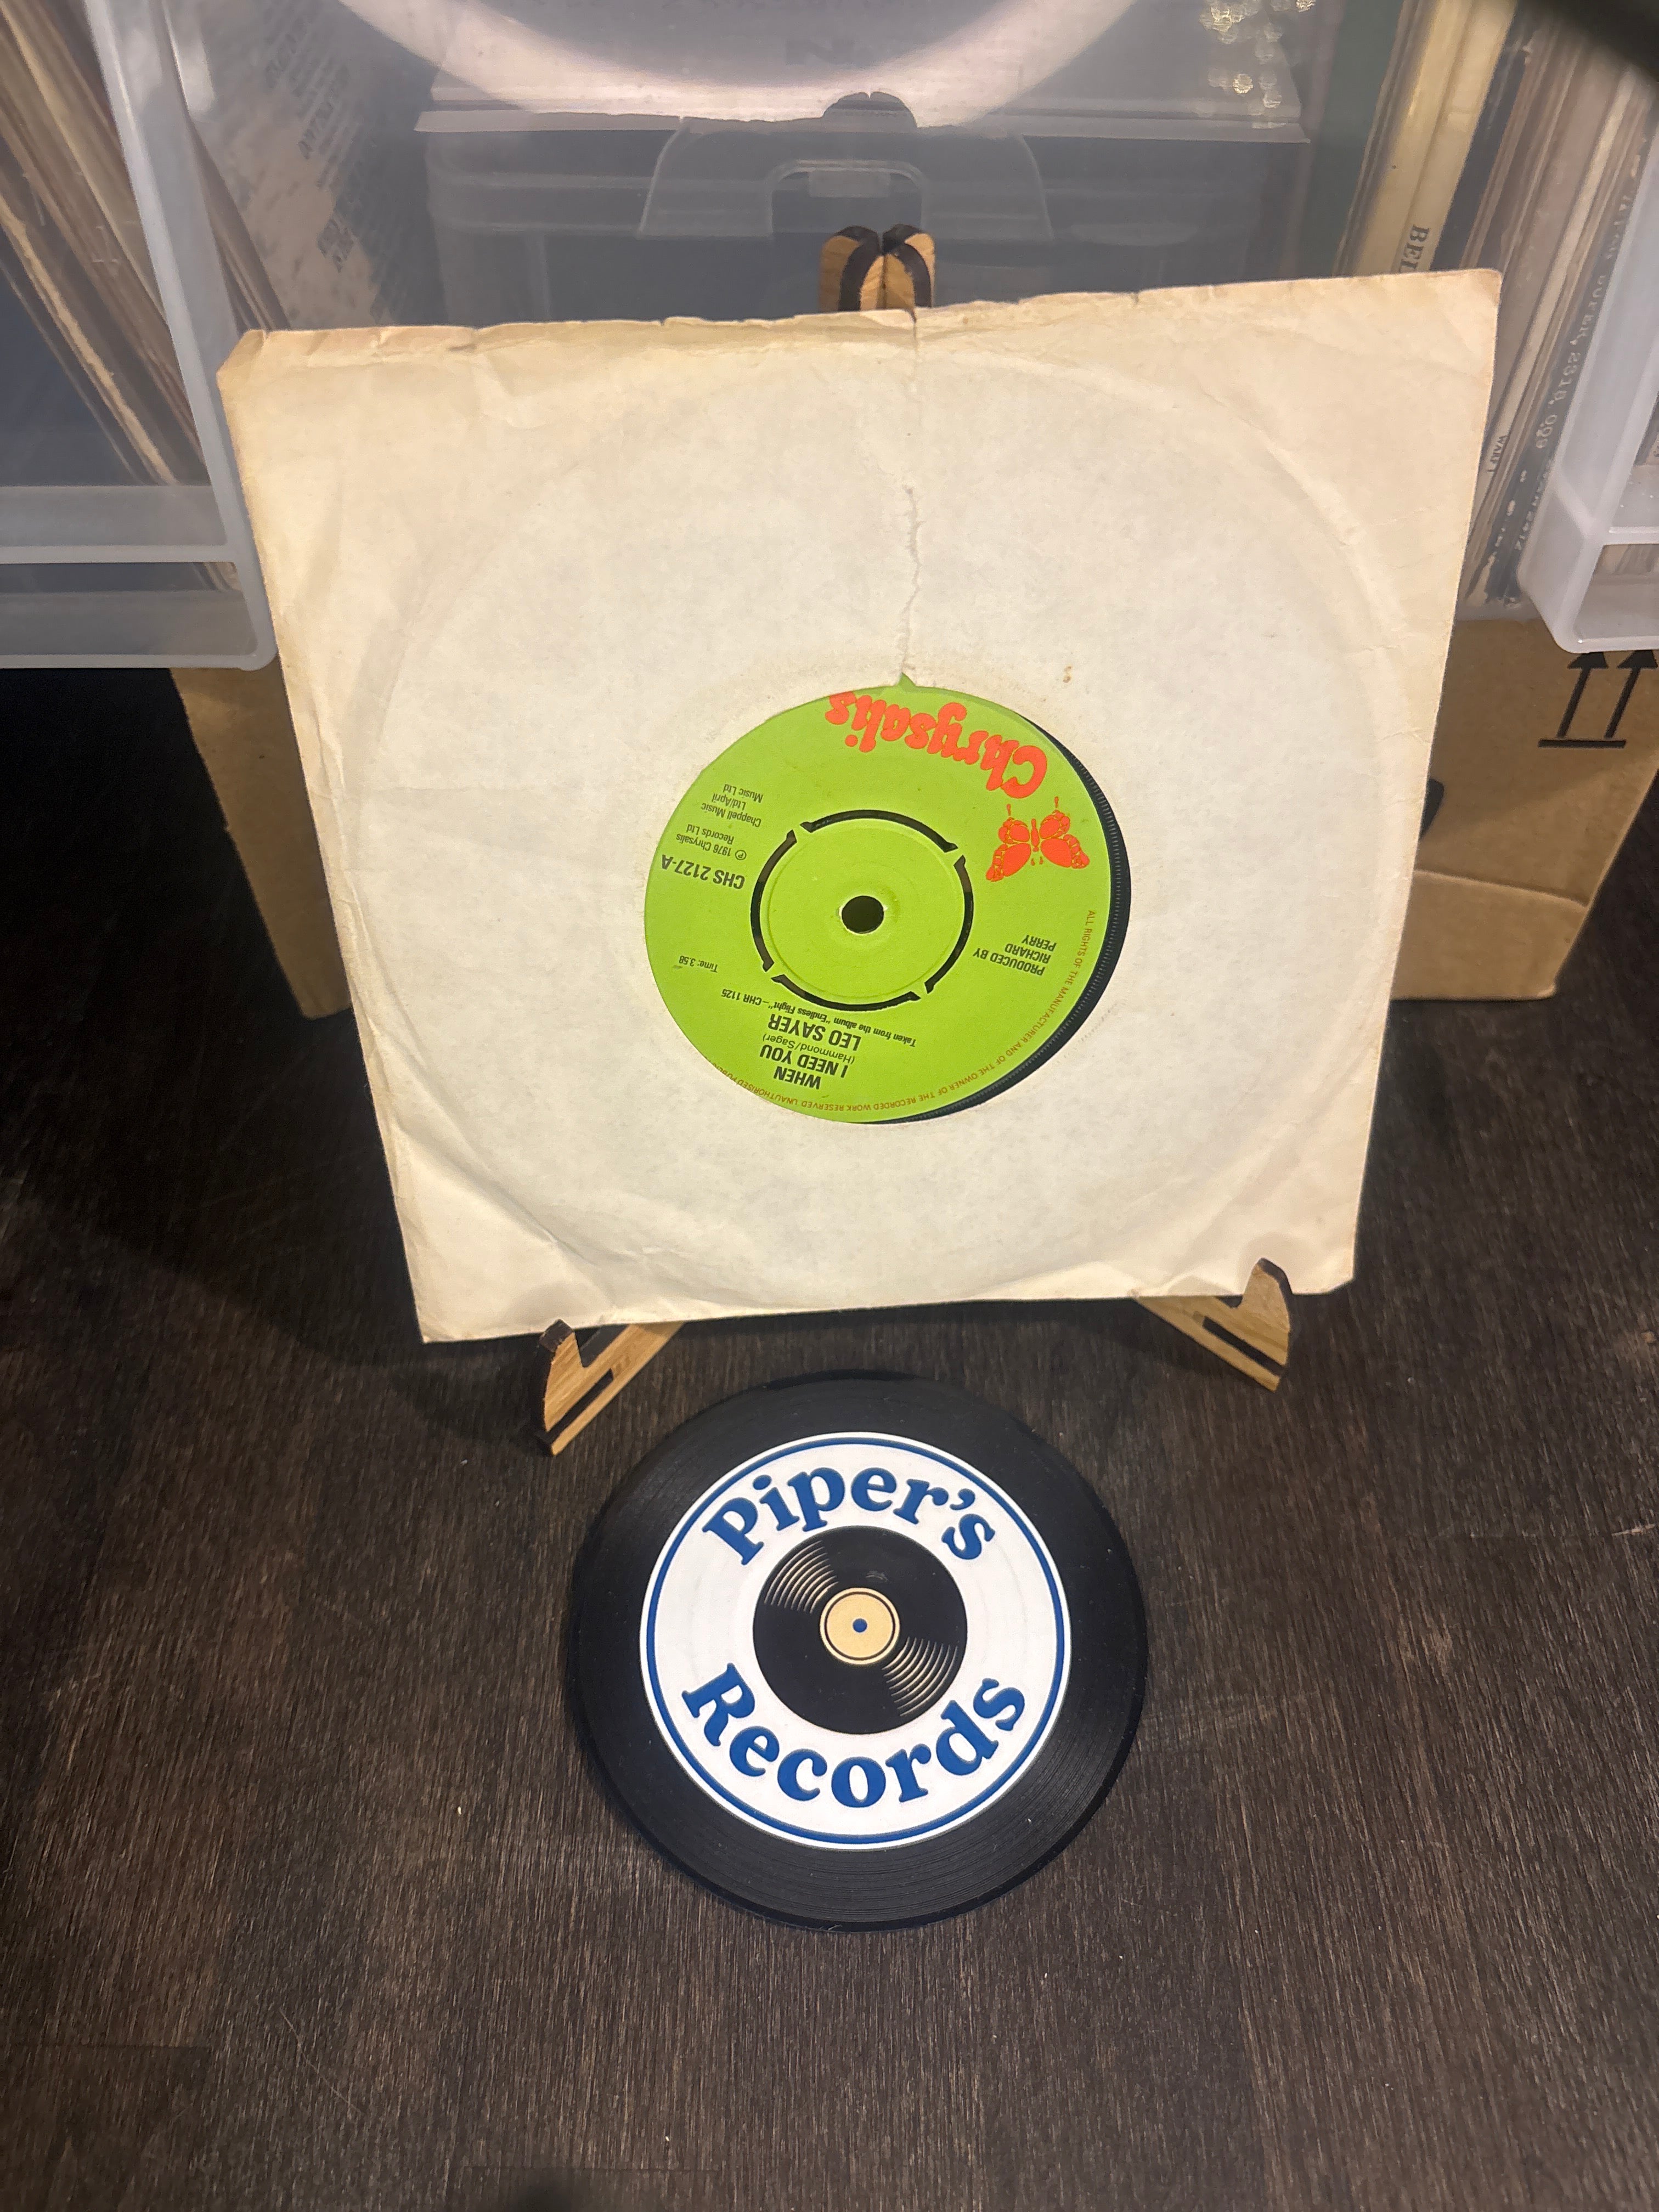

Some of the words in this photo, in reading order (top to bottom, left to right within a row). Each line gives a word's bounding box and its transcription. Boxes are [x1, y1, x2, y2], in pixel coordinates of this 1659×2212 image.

[825, 691, 1047, 799] Chrysalis
[723, 784, 737, 795] Ltd
[738, 788, 763, 803] Music
[701, 803, 726, 817] Music
[712, 793, 746, 811] Ltd/April
[727, 810, 761, 827] Chappell
[686, 824, 700, 835] Ltd
[702, 828, 735, 845] Records
[676, 833, 712, 851] Chrysalis
[713, 844, 732, 857] 1976
[661, 855, 711, 881] 2127-A
[713, 870, 745, 889] CHS
[1085, 910, 1096, 926] ALL
[1021, 934, 1057, 952] PERRY
[1077, 927, 1092, 957] RIGHTS
[679, 955, 696, 967] 3.58
[973, 947, 989, 961] BY
[1005, 943, 1051, 964] RICHARD
[697, 960, 718, 973] Time:
[990, 952, 1046, 976] PRODUCED
[1073, 958, 1081, 968] OF
[1064, 970, 1077, 986] THE
[721, 989, 741, 1001] 1125
[1021, 986, 1068, 1042] MANUFACTURER
[768, 1013, 826, 1041] SAYER
[833, 1017, 857, 1030] album
[858, 1024, 871, 1034] the
[828, 1030, 861, 1051] LEO
[873, 1028, 891, 1040] from
[893, 1033, 916, 1047] Taken
[759, 1044, 792, 1064] YOU
[763, 1034, 855, 1064] (Hammond/Sager)
[1005, 1041, 1022, 1057] AND
[797, 1053, 839, 1075] NEED
[995, 1056, 1006, 1066] OF
[841, 1065, 848, 1078] I
[978, 1063, 995, 1076] THE
[774, 1066, 821, 1090] WHEN
[949, 1073, 978, 1089] OWNER
[737, 1080, 798, 1105] UNAUTHORISED
[918, 1092, 935, 1102] THE
[938, 1087, 948, 1096] OF
[802, 1101, 844, 1111] RESERVED
[873, 1097, 916, 1110] RECORDED
[702, 1466, 996, 1565] Piper's
[682, 1662, 1026, 1809] Records
